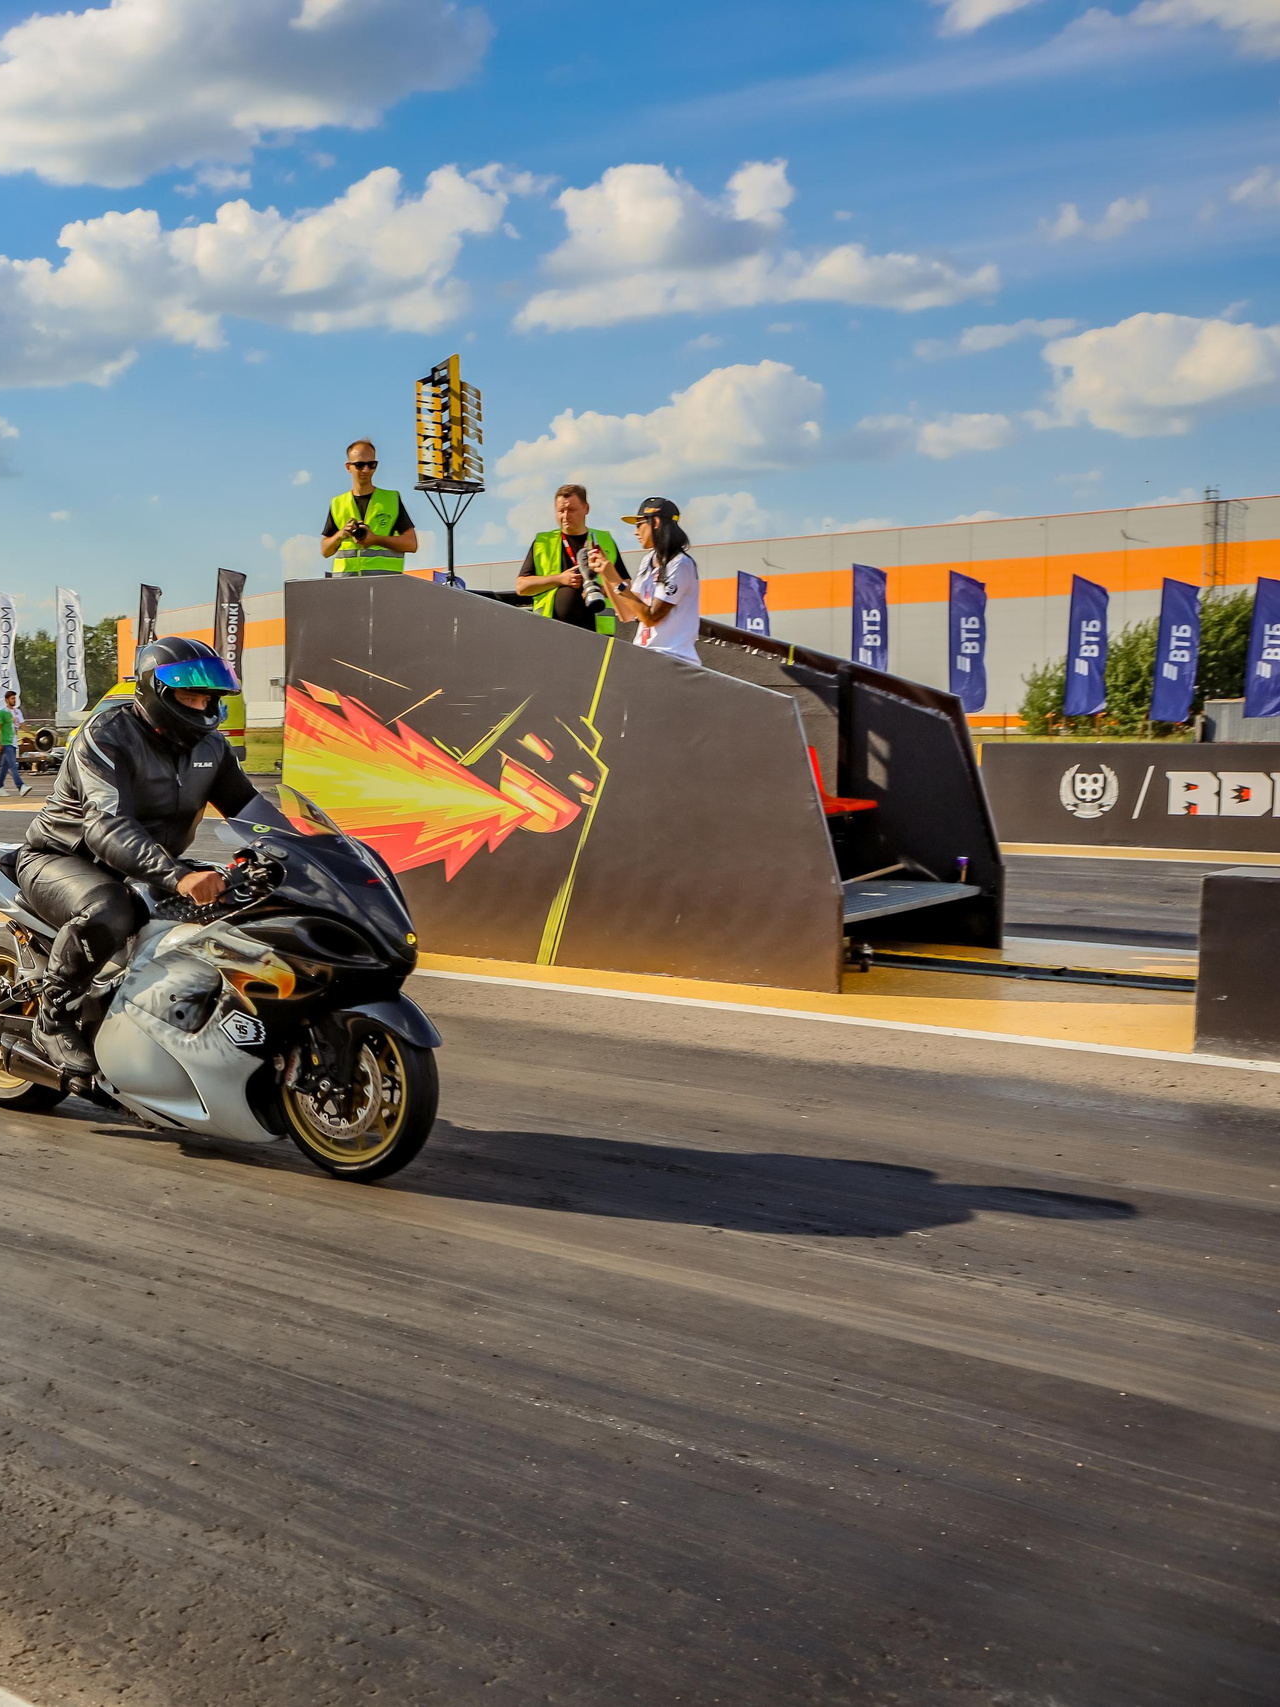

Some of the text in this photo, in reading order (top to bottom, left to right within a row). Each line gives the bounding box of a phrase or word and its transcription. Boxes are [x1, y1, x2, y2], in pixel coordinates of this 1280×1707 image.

[862, 608, 882, 647] ВТБ
[960, 616, 981, 654] ВТБ
[1078, 619, 1102, 658] ВТБ
[1168, 624, 1192, 663] ВТБ
[1261, 623, 1280, 661] ВТБ
[1165, 771, 1280, 818] RD
